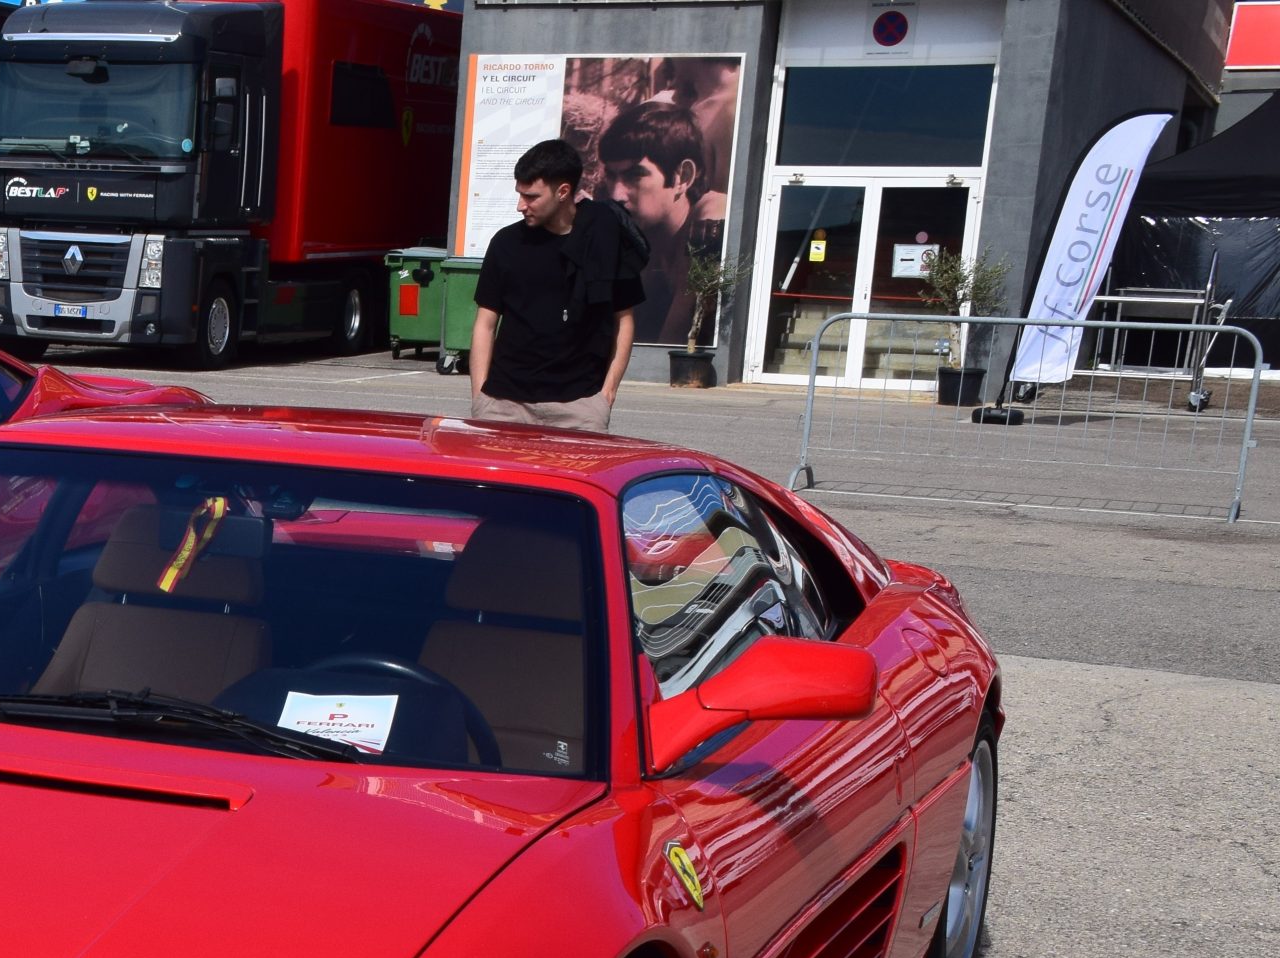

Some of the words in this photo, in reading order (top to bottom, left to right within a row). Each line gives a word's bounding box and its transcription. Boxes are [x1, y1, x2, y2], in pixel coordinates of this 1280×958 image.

[483, 63, 521, 71] RICARDO
[524, 63, 555, 71] TORMO
[496, 86, 527, 94] CIRCUIT
[515, 97, 545, 105] CIRCUIT
[328, 713, 349, 721] P
[296, 720, 375, 729] FERRARI
